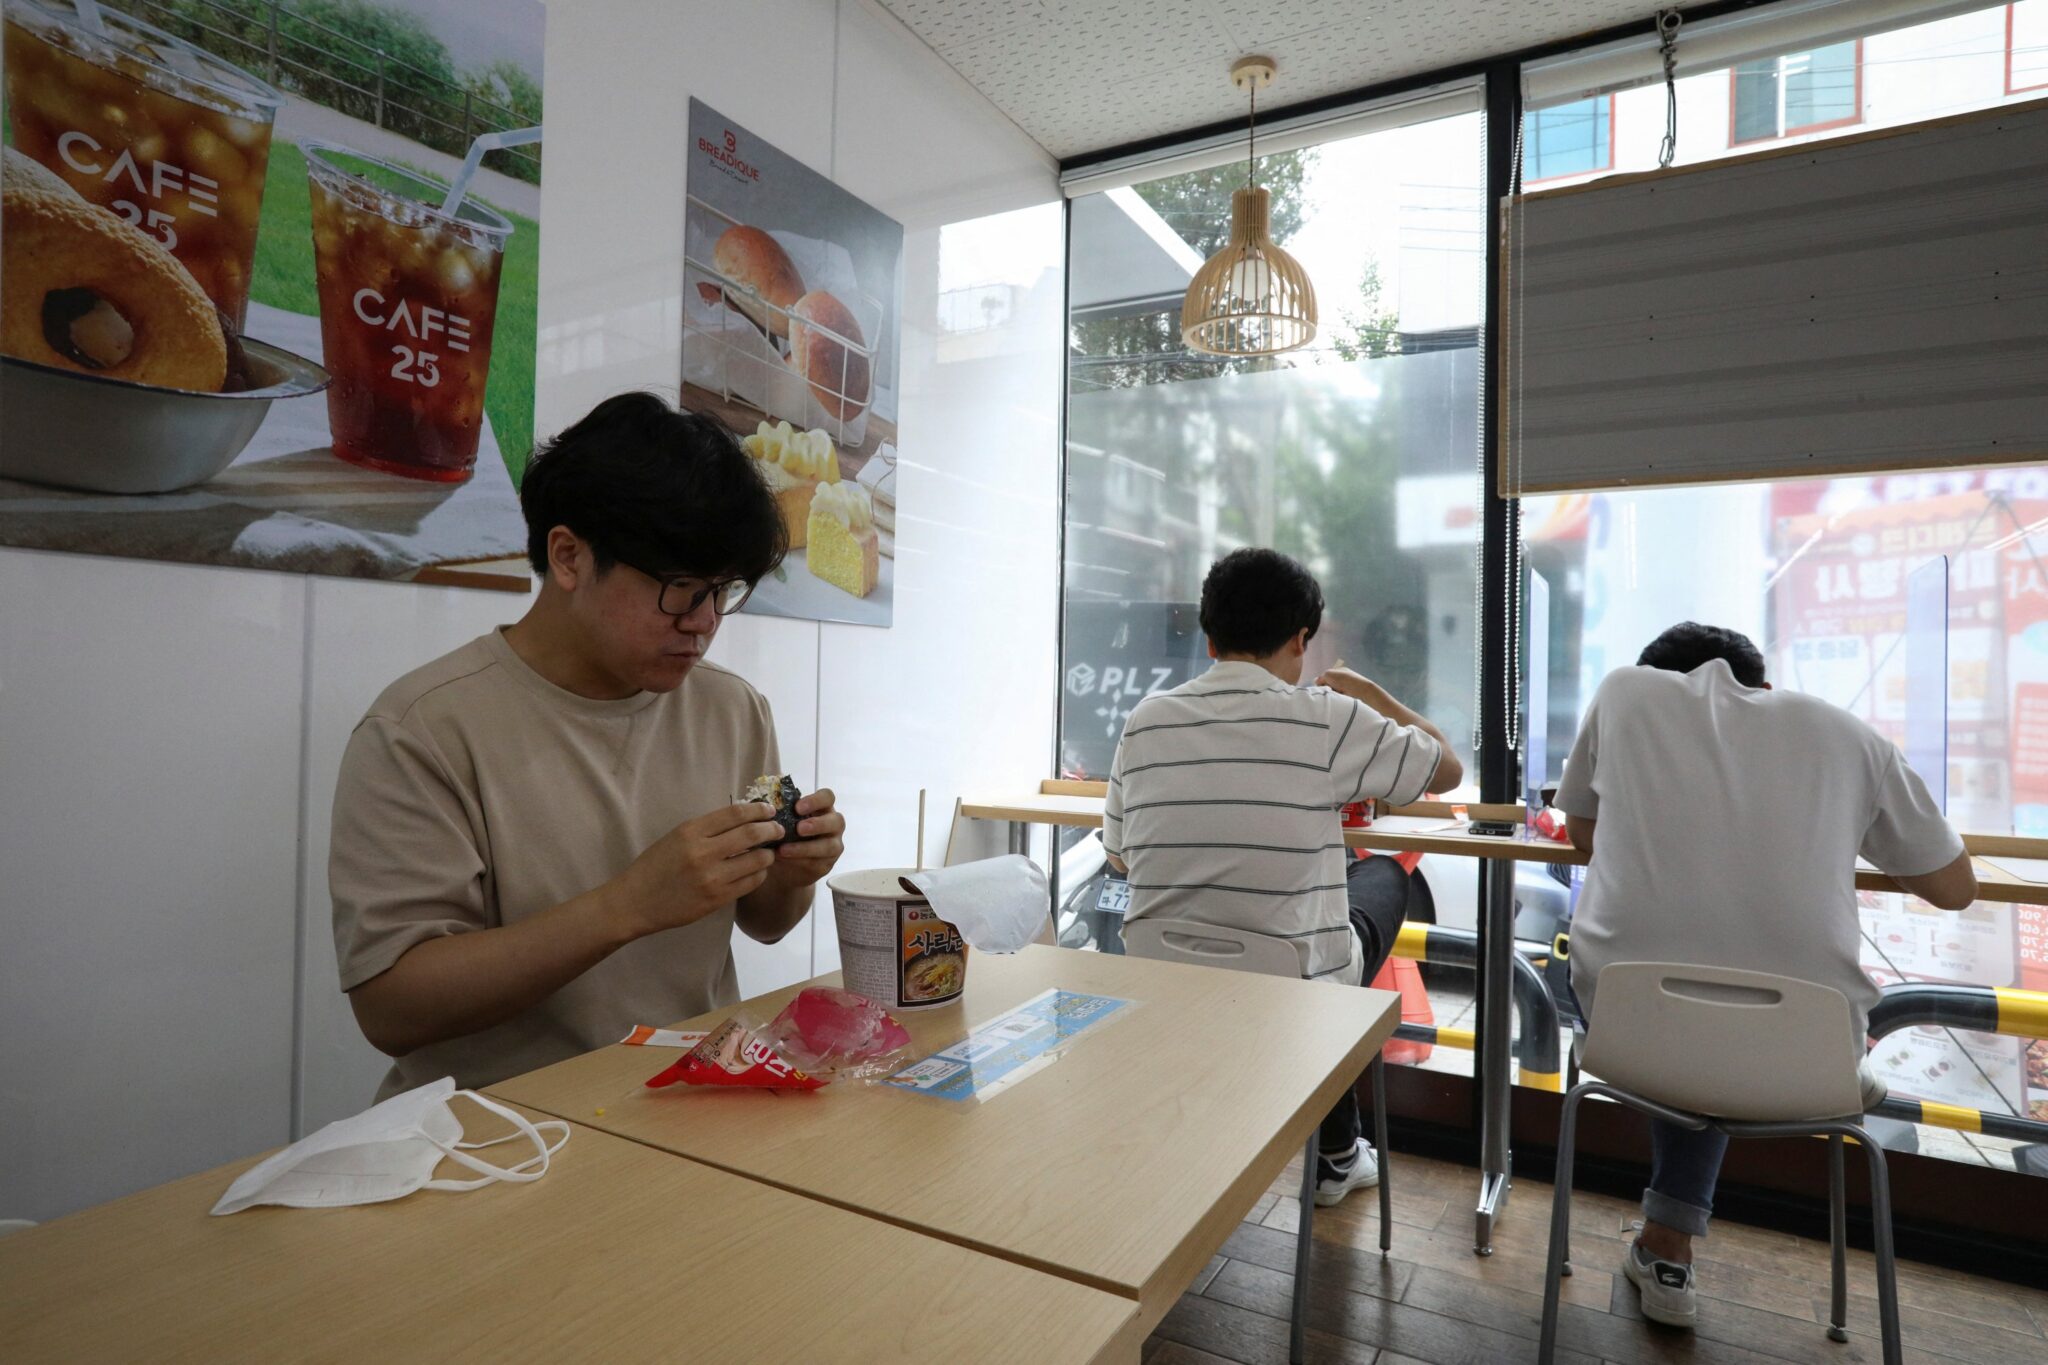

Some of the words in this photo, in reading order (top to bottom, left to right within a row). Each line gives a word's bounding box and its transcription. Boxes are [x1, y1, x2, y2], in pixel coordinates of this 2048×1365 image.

[56, 131, 219, 218] CAFE
[698, 137, 761, 182] BREADIQUE
[352, 288, 471, 353] CAFE
[391, 345, 440, 388] 25
[1098, 665, 1173, 695] PLZ
